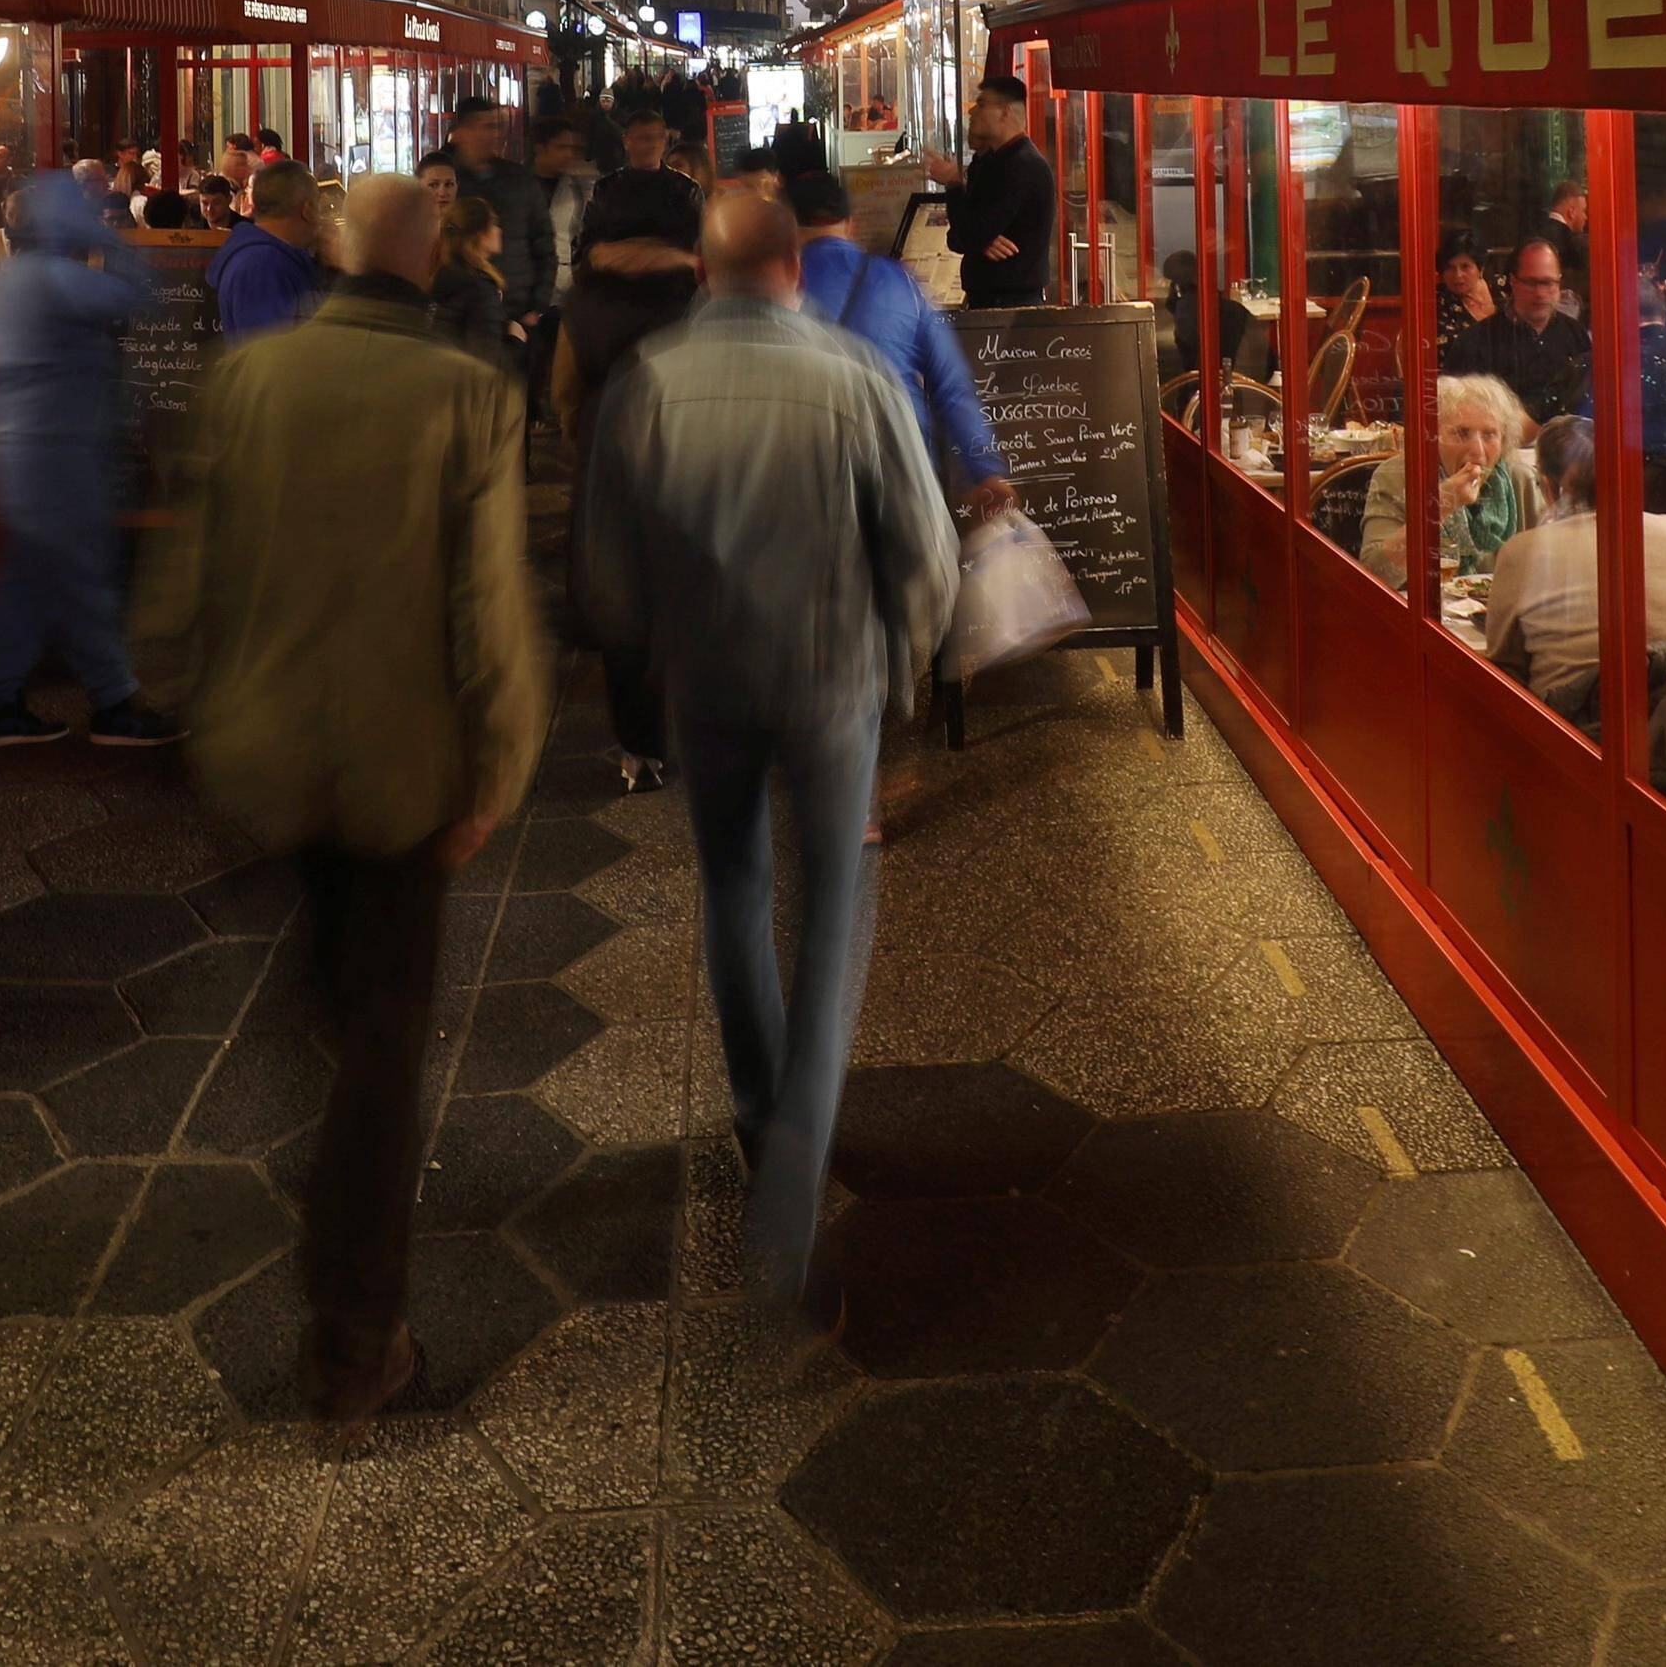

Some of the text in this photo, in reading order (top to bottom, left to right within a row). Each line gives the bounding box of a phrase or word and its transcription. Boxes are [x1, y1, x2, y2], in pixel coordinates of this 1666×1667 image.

[405, 13, 440, 43] La Pizza Cresci
[978, 334, 1092, 361] Maison Cresci
[979, 401, 1087, 424] SUGGESTION
[1043, 496, 1059, 514] de
